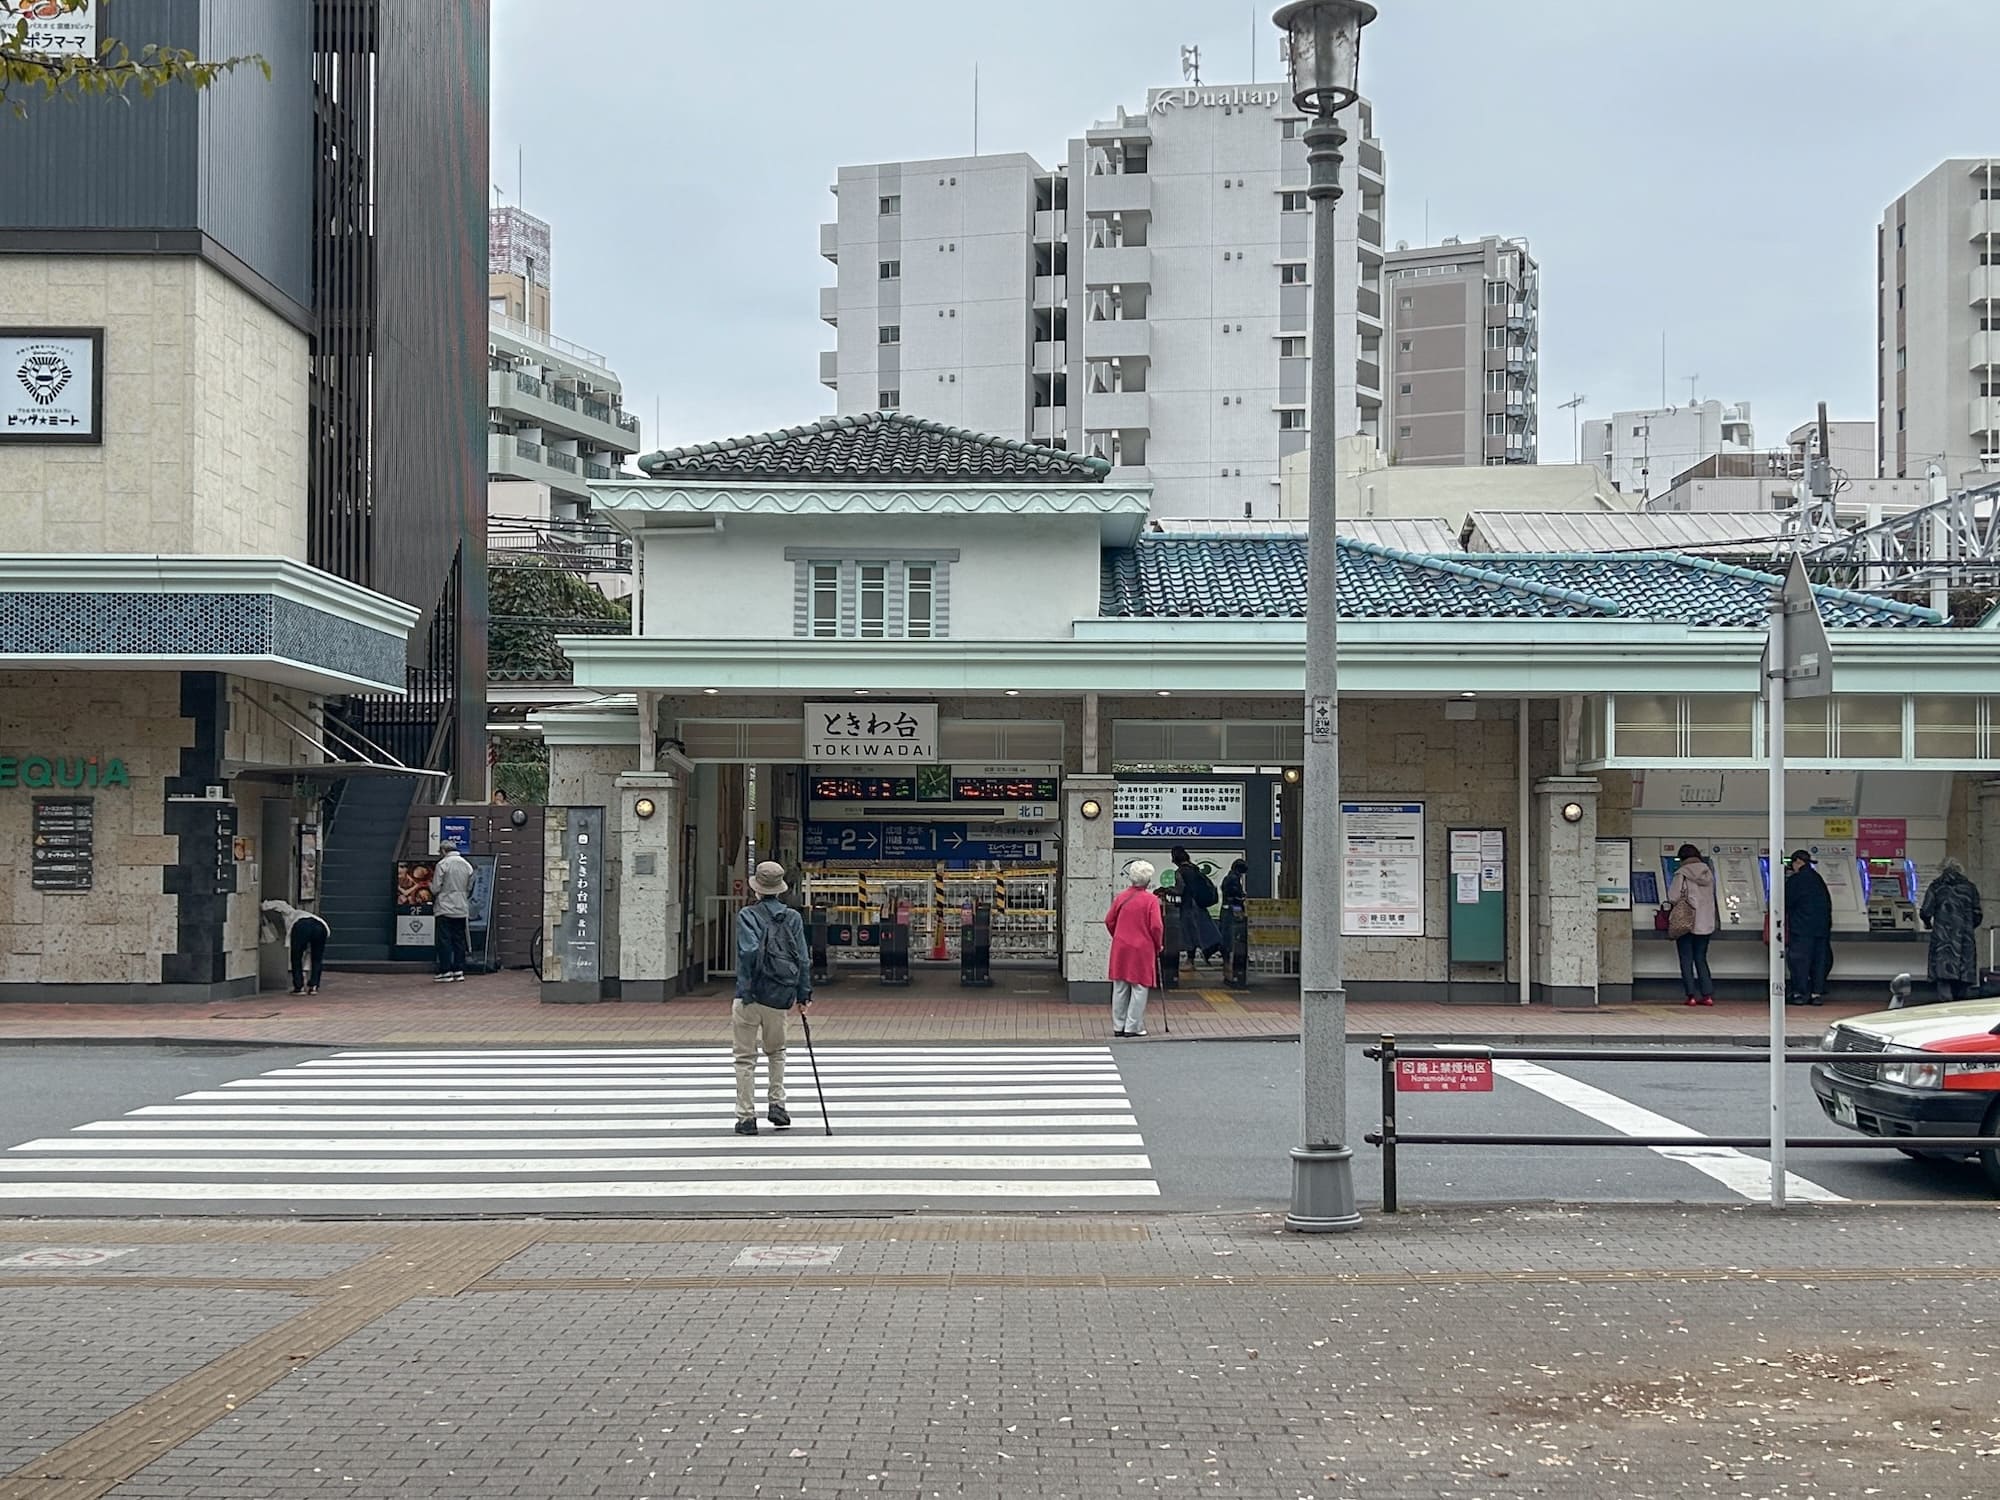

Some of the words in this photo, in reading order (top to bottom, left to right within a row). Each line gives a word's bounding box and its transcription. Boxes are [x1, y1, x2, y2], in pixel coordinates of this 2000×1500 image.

[1184, 87, 1279, 108] Dualtap
[824, 711, 918, 737] ときわ台
[812, 744, 931, 756] TOKIWADAI
[1019, 805, 1043, 817] 北口
[1149, 826, 1202, 836] SHUKUTOKU
[841, 828, 856, 851] 2
[929, 828, 937, 851] 1
[576, 853, 589, 914] ときわ台駅
[410, 906, 422, 915] 2F
[1417, 1062, 1486, 1074] 路上禁煙地区
